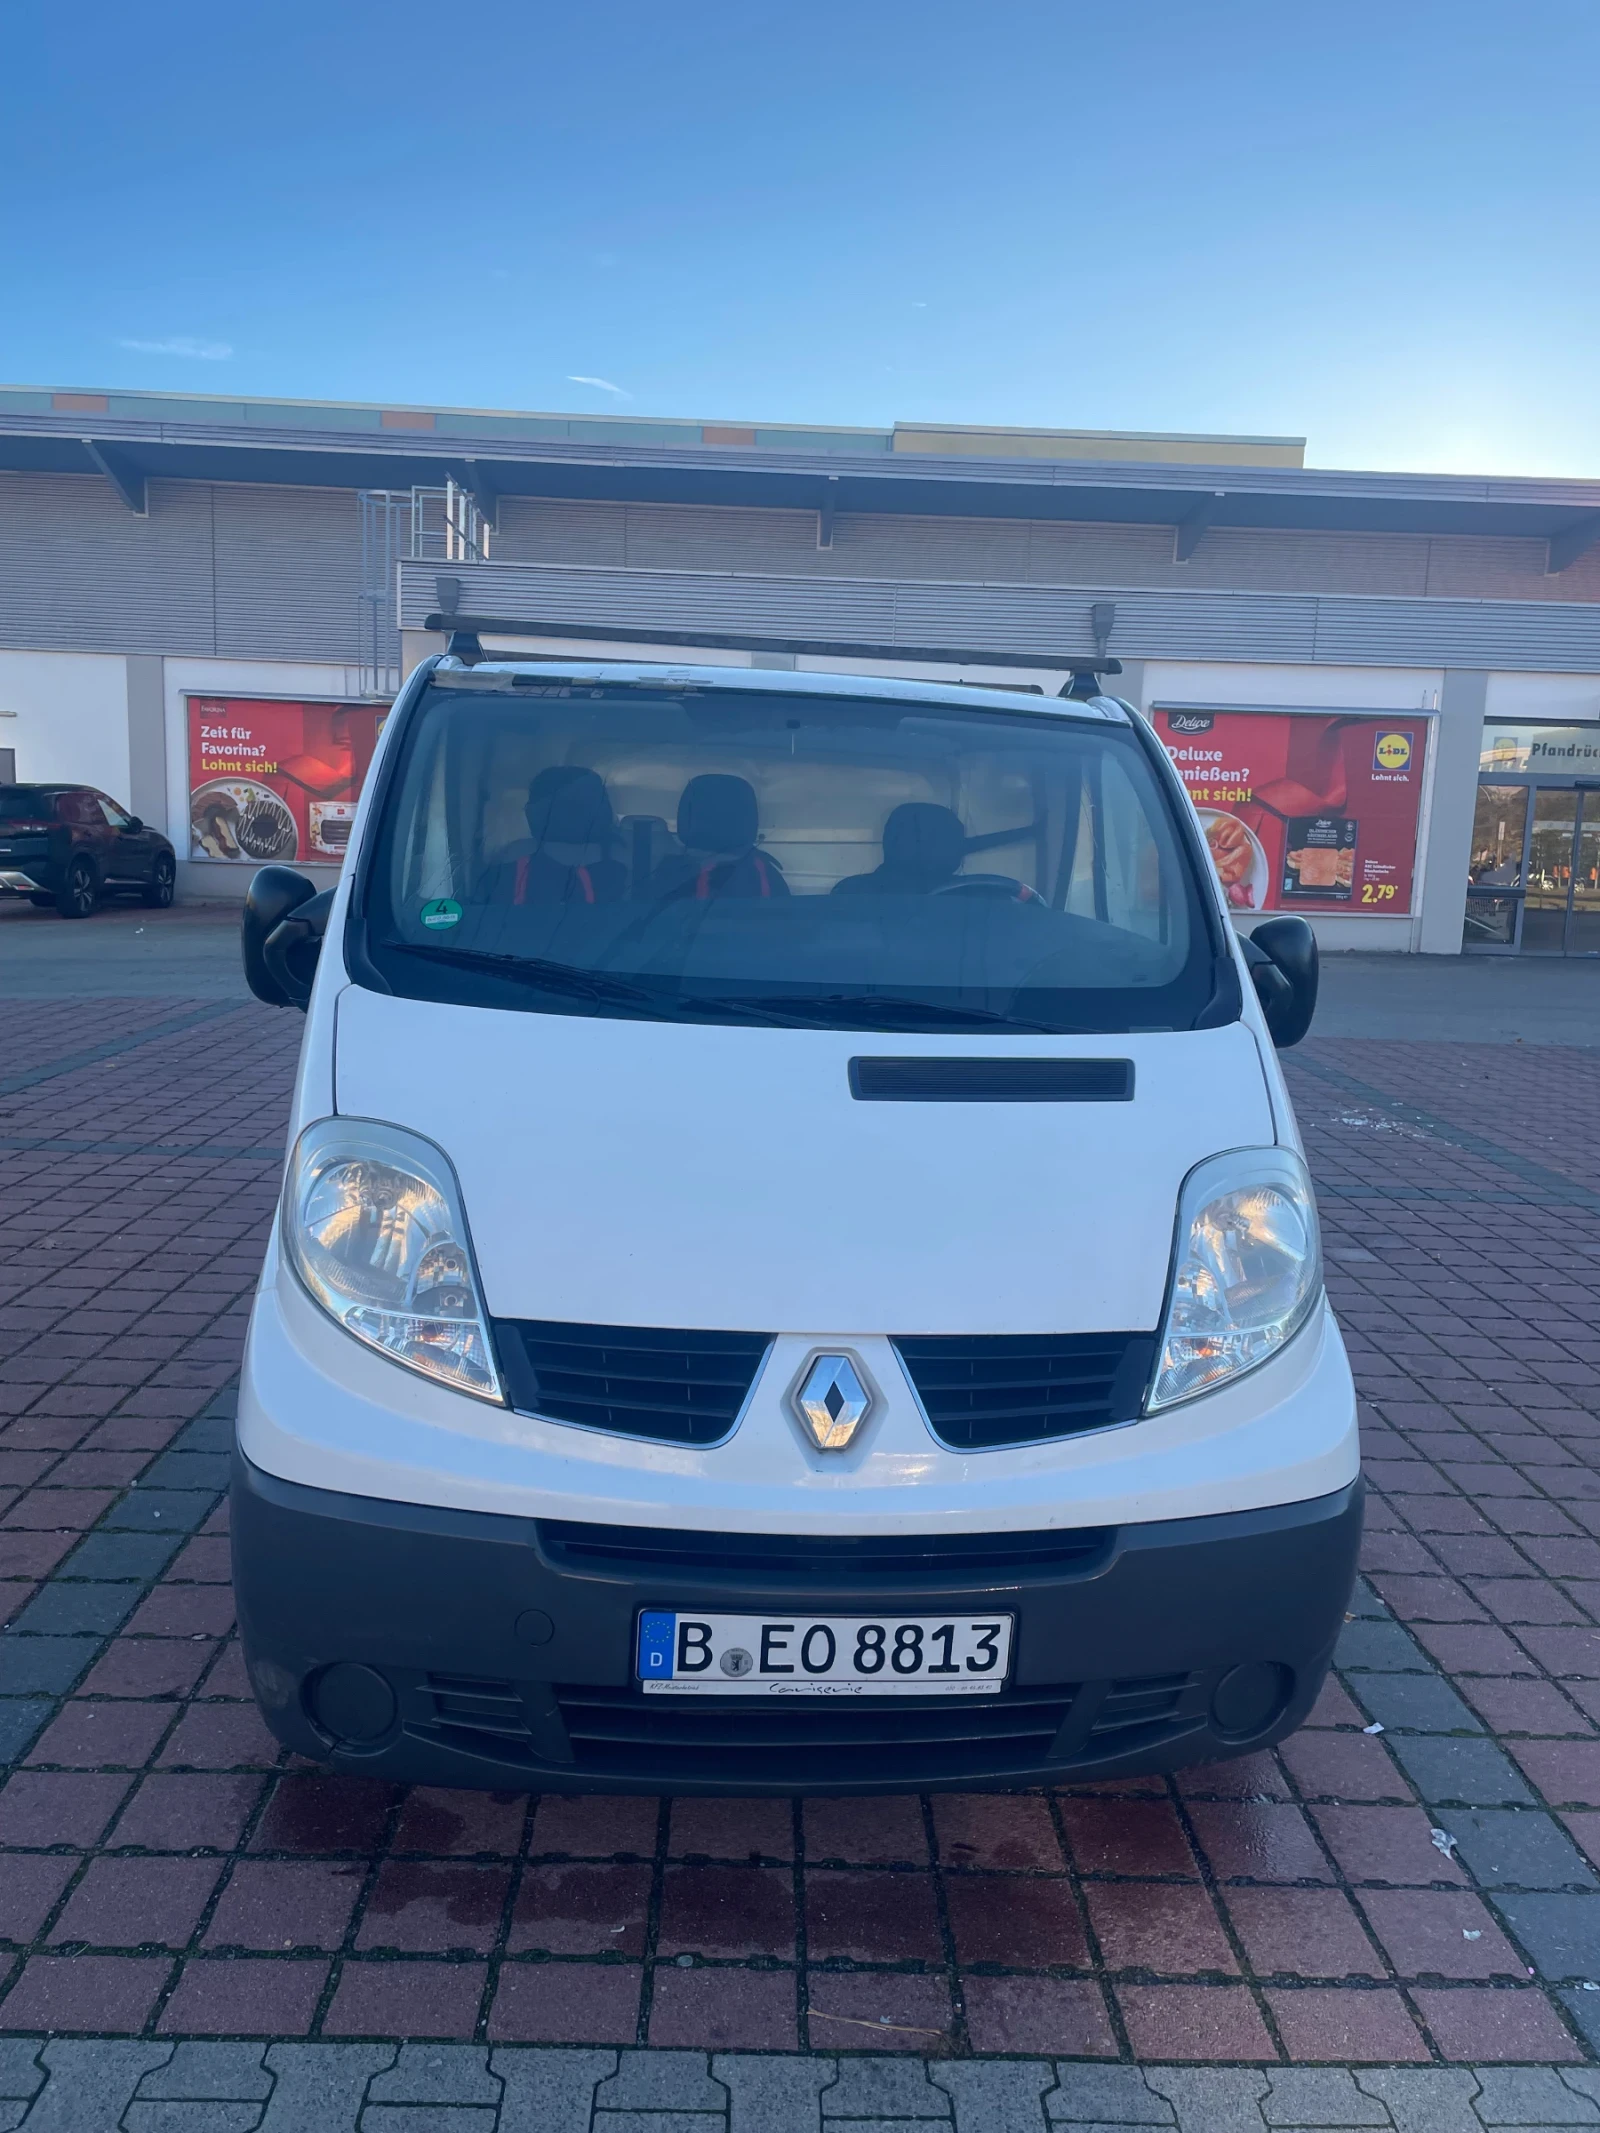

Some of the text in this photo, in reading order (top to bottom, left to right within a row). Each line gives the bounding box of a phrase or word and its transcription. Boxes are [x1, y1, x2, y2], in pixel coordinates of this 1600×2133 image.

[1171, 714, 1211, 731] Deluxe
[200, 725, 252, 740] Zeit für
[201, 742, 267, 757] Favorina?
[1165, 746, 1223, 761] Deluxe
[1532, 742, 1600, 758] Pfandrüc
[202, 758, 278, 774] Lohnt sich!
[1371, 773, 1410, 782] Lohnt sich.
[1213, 786, 1252, 802] sich!
[435, 900, 448, 914] 4
[677, 1621, 713, 1672] B
[759, 1624, 836, 1674] EO
[853, 1623, 1001, 1675] 8813
[650, 1652, 663, 1667] D
